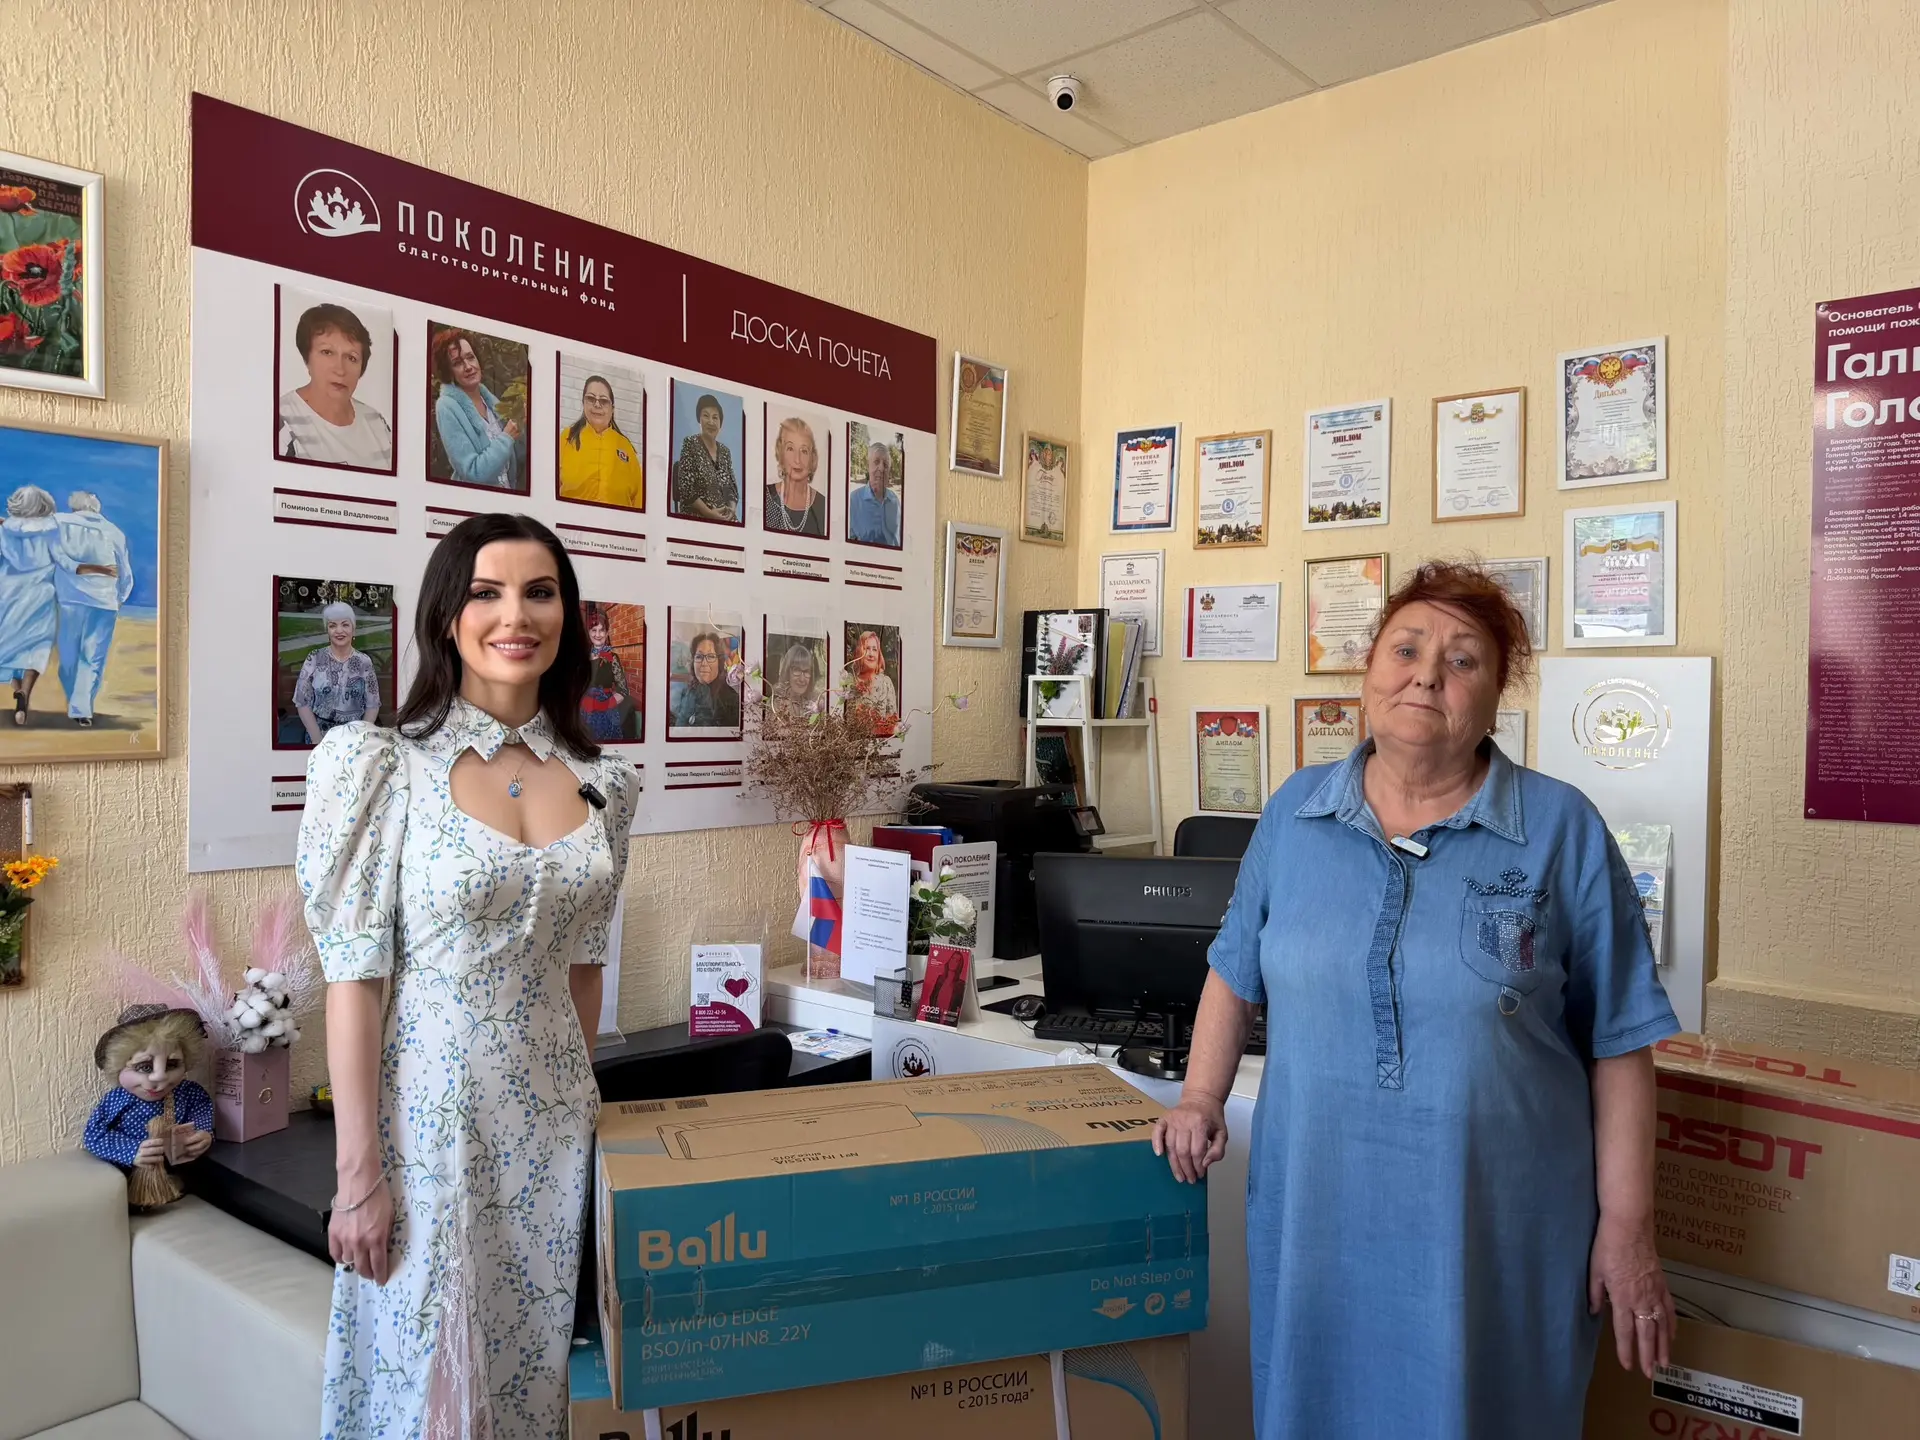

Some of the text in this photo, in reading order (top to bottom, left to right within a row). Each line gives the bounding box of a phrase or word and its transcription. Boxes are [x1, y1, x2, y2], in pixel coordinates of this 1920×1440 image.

[398, 200, 616, 292] ПОКОЛЕНИЕ
[398, 242, 616, 311] благотворительный фонд
[1828, 304, 1914, 323] Основатель
[1828, 322, 1886, 337] помощи
[730, 309, 892, 381] ДОСКА ПОЧЕТА
[1331, 433, 1362, 445] ДИПЛОМ
[1830, 434, 1899, 445] Благотворительный
[1863, 441, 1882, 449] 2017
[1217, 460, 1245, 470] ДИПЛОМ
[281, 502, 390, 521] Поминова Елена Владленовна
[1308, 727, 1354, 737] ДИПЛОМ
[1583, 746, 1659, 759] ПОКОЛЕНИЕ
[954, 854, 991, 863] ПОКОЛЕНИЕ
[1143, 885, 1193, 898] PHILIPS
[920, 1004, 940, 1014] 2025
[1650, 1039, 1857, 1088] TOSO
[1025, 1099, 1143, 1113] OLYMPIO EDGE
[1086, 1116, 1160, 1133] allu
[774, 1156, 820, 1165] RUSSIA
[1657, 1160, 1792, 1201] AIR CONDITIONER
[913, 1192, 920, 1204] В
[923, 1186, 975, 1203] РОССИИ
[1655, 1188, 1748, 1218] NDOOR UNIT
[1657, 1174, 1786, 1214] MOUNTED MODEL
[930, 1203, 952, 1214] 2015
[1653, 1208, 1747, 1240] YRA INVERTER
[638, 1211, 767, 1270] Ballu
[1655, 1224, 1743, 1256] 12H-SLyR2/I
[1090, 1267, 1194, 1291] Do Not Step On
[640, 1305, 780, 1338] OLYMPIO EDGE
[641, 1323, 812, 1361] BSO/in-07HN8_22Y
[910, 1370, 1029, 1401] №1 В РОССИИ
[958, 1399, 965, 1409] с
[968, 1394, 998, 1409] 2015
